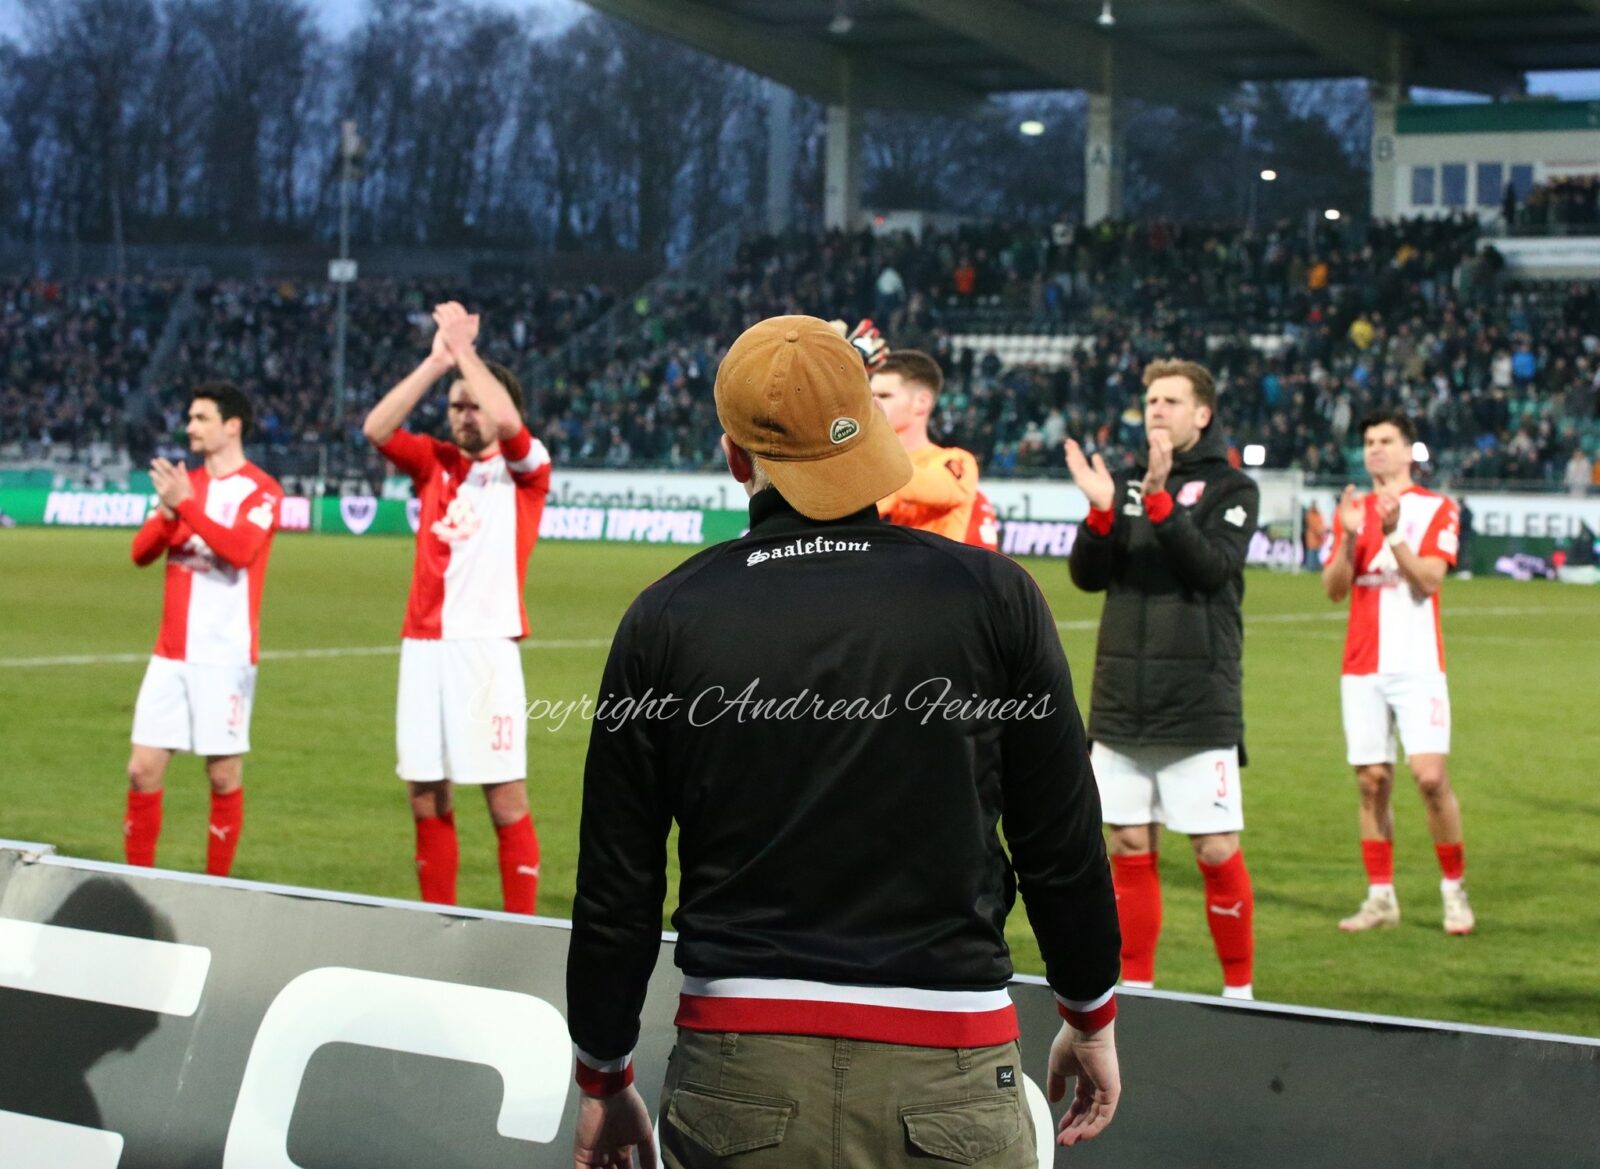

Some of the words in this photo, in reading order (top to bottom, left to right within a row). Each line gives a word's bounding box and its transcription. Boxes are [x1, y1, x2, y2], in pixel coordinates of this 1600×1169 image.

[746, 536, 872, 567] Saalefront
[490, 714, 514, 753] 33
[1214, 761, 1228, 799] 3
